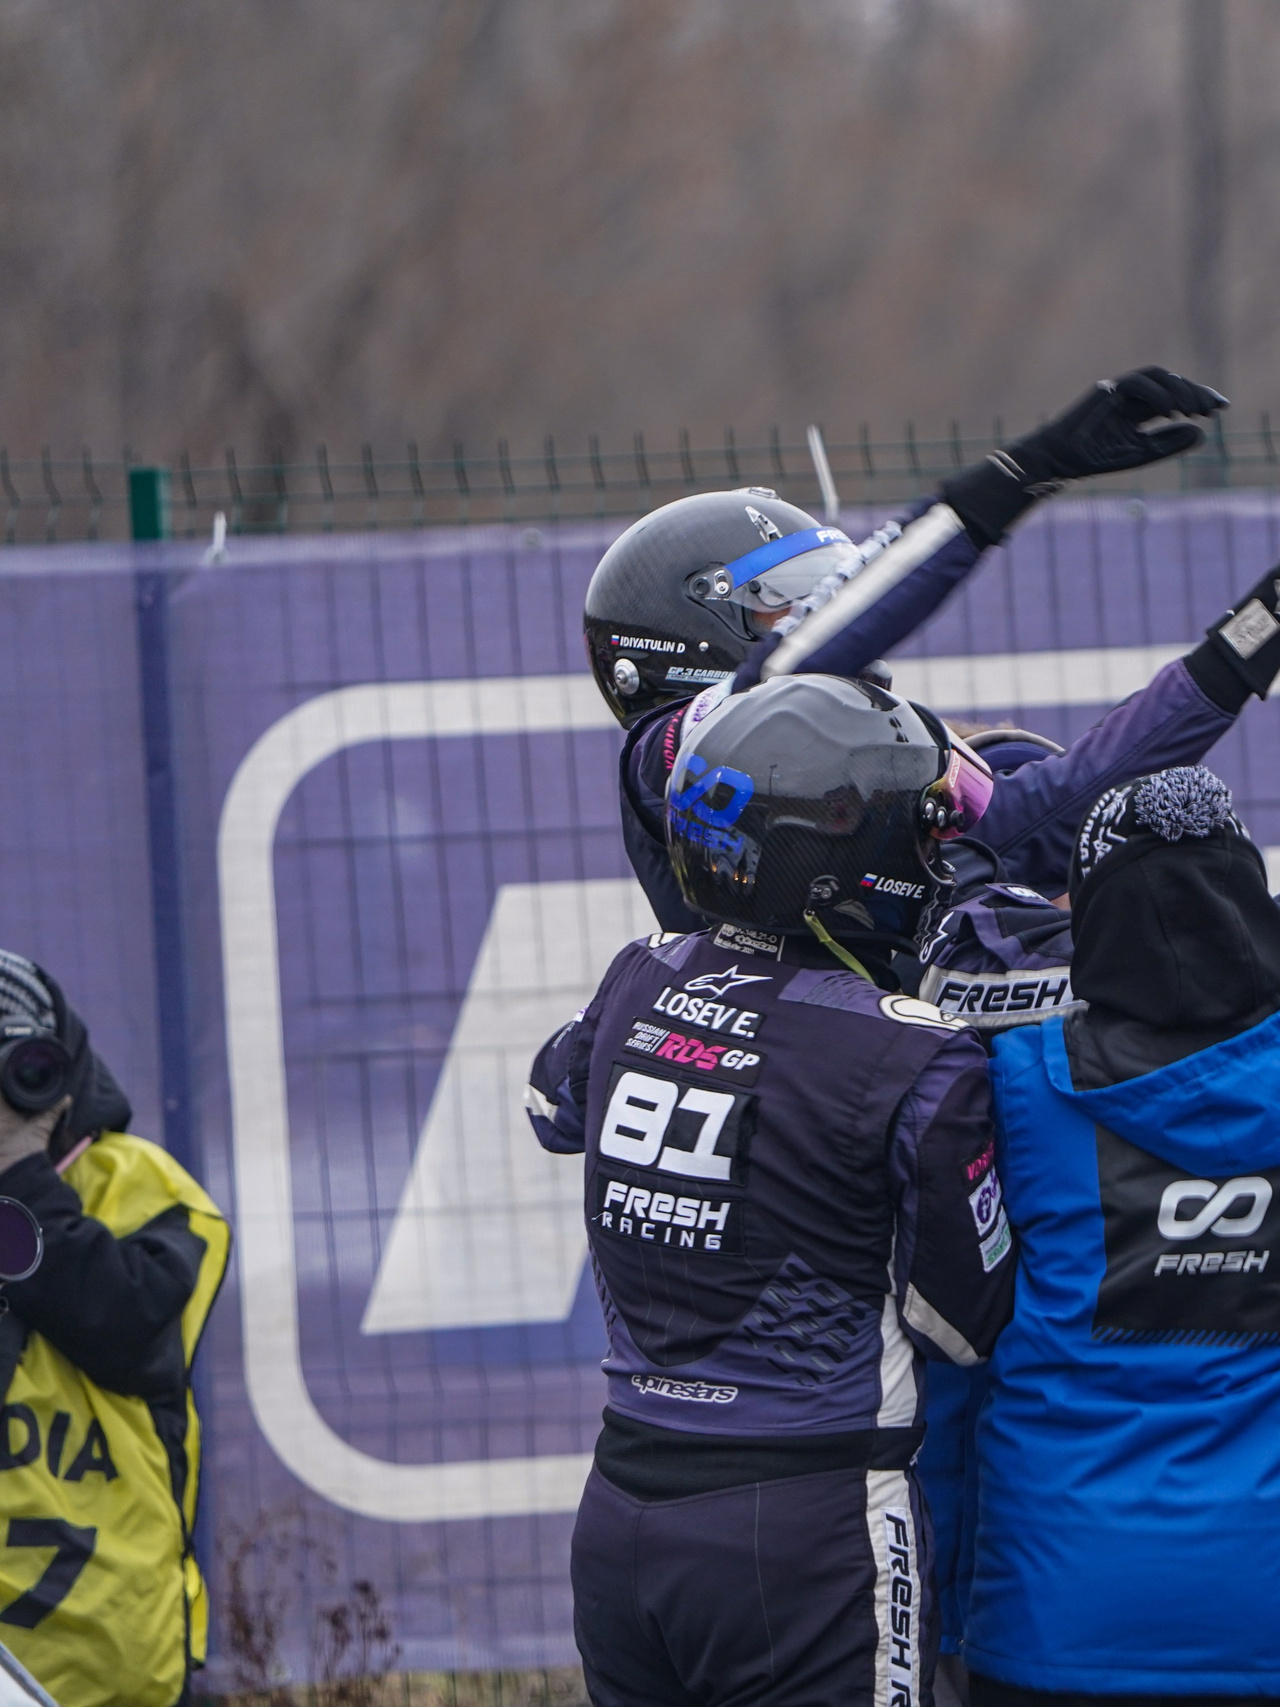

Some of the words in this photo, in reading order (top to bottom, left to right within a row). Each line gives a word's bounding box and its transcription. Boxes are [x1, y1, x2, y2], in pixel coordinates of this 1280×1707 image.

[620, 636, 676, 653] IDIYATULIN
[676, 642, 686, 653] D
[874, 877, 917, 897] LOSEV
[652, 986, 737, 1030] LOSEV
[730, 1011, 759, 1039] E.
[936, 978, 1069, 1013] FRESH
[625, 1038, 654, 1052] SERIES
[632, 1021, 665, 1037] RUSSIAN
[636, 1031, 660, 1043] DRIFT
[655, 1032, 728, 1071] RDS
[720, 1049, 761, 1071] GP
[600, 1071, 736, 1181] 81
[603, 1180, 731, 1231] FRESH
[602, 1211, 723, 1251] RACING
[1154, 1250, 1270, 1277] FRESH
[631, 1374, 739, 1404] alpinestars
[0, 1517, 97, 1630] 7
[885, 1513, 914, 1671] FRESH
